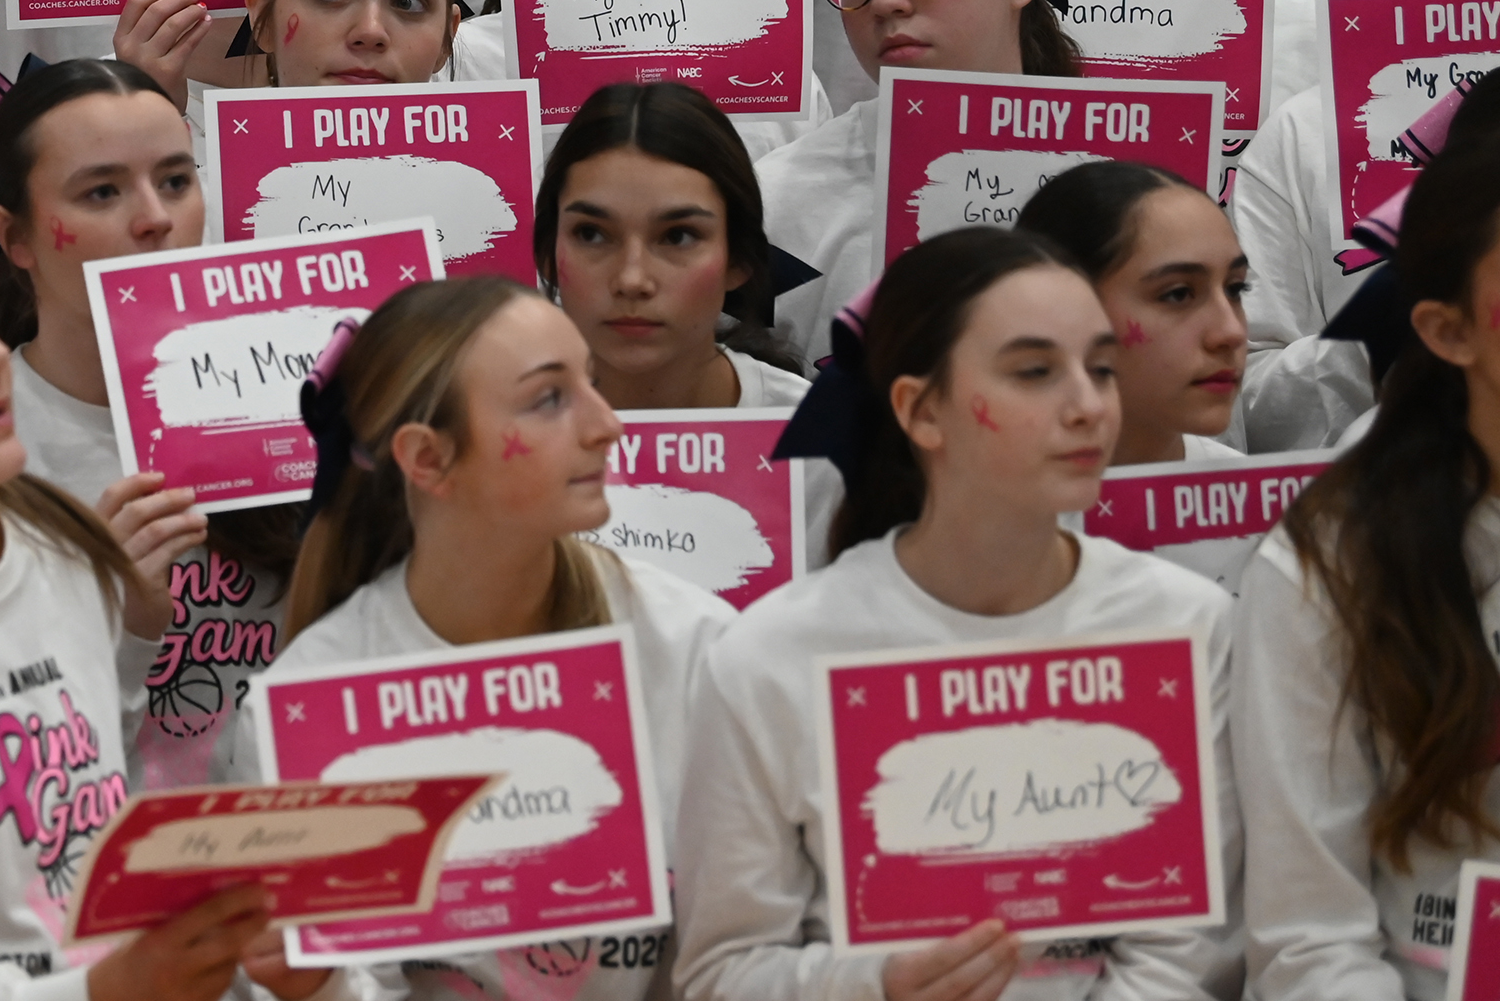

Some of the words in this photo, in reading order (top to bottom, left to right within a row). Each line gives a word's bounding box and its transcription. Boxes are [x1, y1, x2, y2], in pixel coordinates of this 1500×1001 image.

[579, 0, 688, 44] Timmy!
[1394, 6, 1405, 45] I
[1425, 1, 1500, 43] PLAY
[677, 67, 703, 79] NABC
[1406, 67, 1439, 99] My
[716, 95, 790, 105] #COACHESVSCANCER
[958, 94, 970, 135] I
[990, 96, 1072, 141] PLAY
[1084, 101, 1151, 143] FOR
[283, 110, 294, 149] I
[313, 106, 390, 148] PLAY
[403, 104, 470, 144] FOR
[311, 174, 352, 208] My
[965, 167, 1015, 200] My
[169, 272, 186, 312] I
[202, 259, 284, 307] PLAY
[297, 249, 370, 297] FOR
[190, 352, 242, 398] My
[655, 433, 726, 474] FOR
[1145, 487, 1156, 532] I
[1173, 482, 1248, 529] PLAY
[342, 687, 358, 735] I
[377, 673, 470, 730] PLAY
[482, 662, 563, 717] FOR
[905, 673, 920, 721] I
[941, 664, 1032, 716] PLAY
[1046, 655, 1123, 708] FOR
[923, 765, 997, 846] My
[1011, 761, 1107, 819] Aunt
